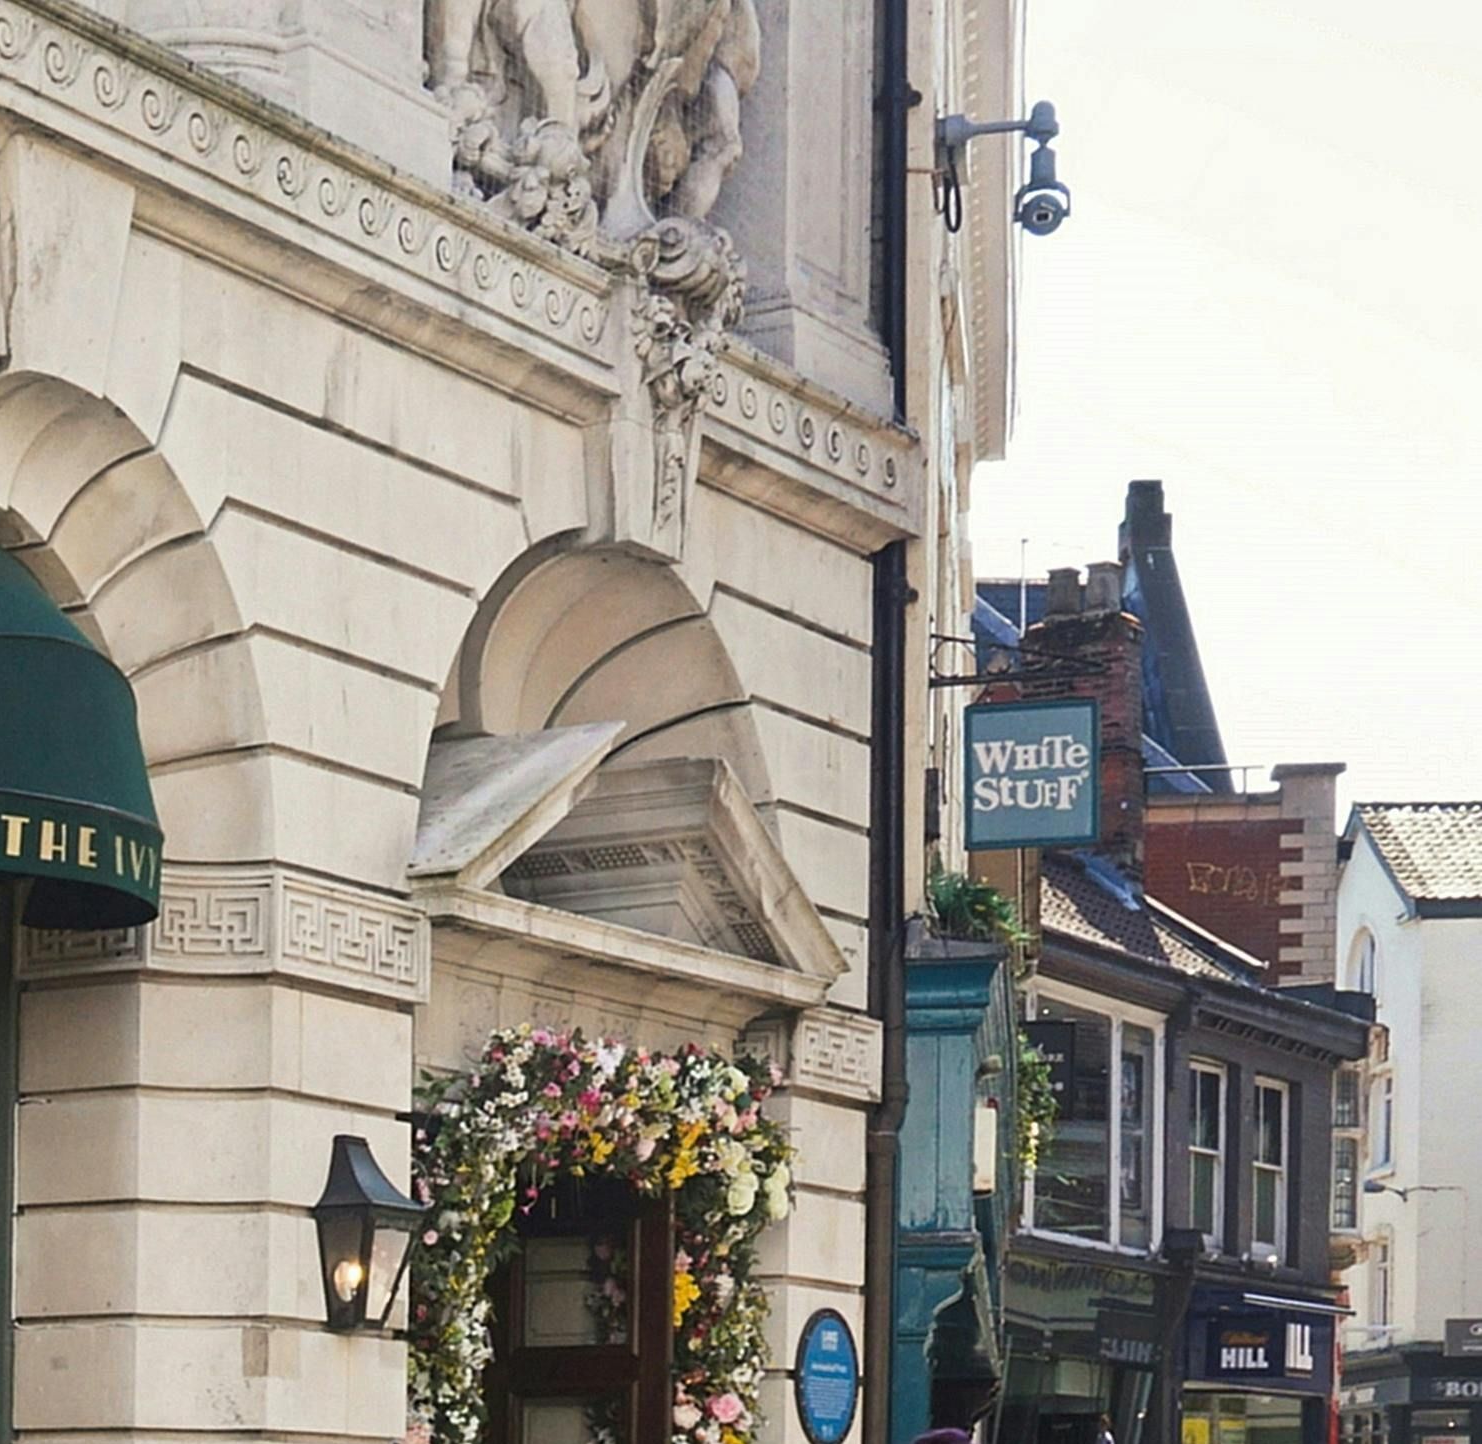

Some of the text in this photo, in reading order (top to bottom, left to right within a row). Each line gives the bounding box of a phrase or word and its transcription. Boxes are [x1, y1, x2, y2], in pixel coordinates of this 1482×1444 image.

[0, 813, 158, 890] THE IVY
[1220, 1347, 1270, 1370] HILL
